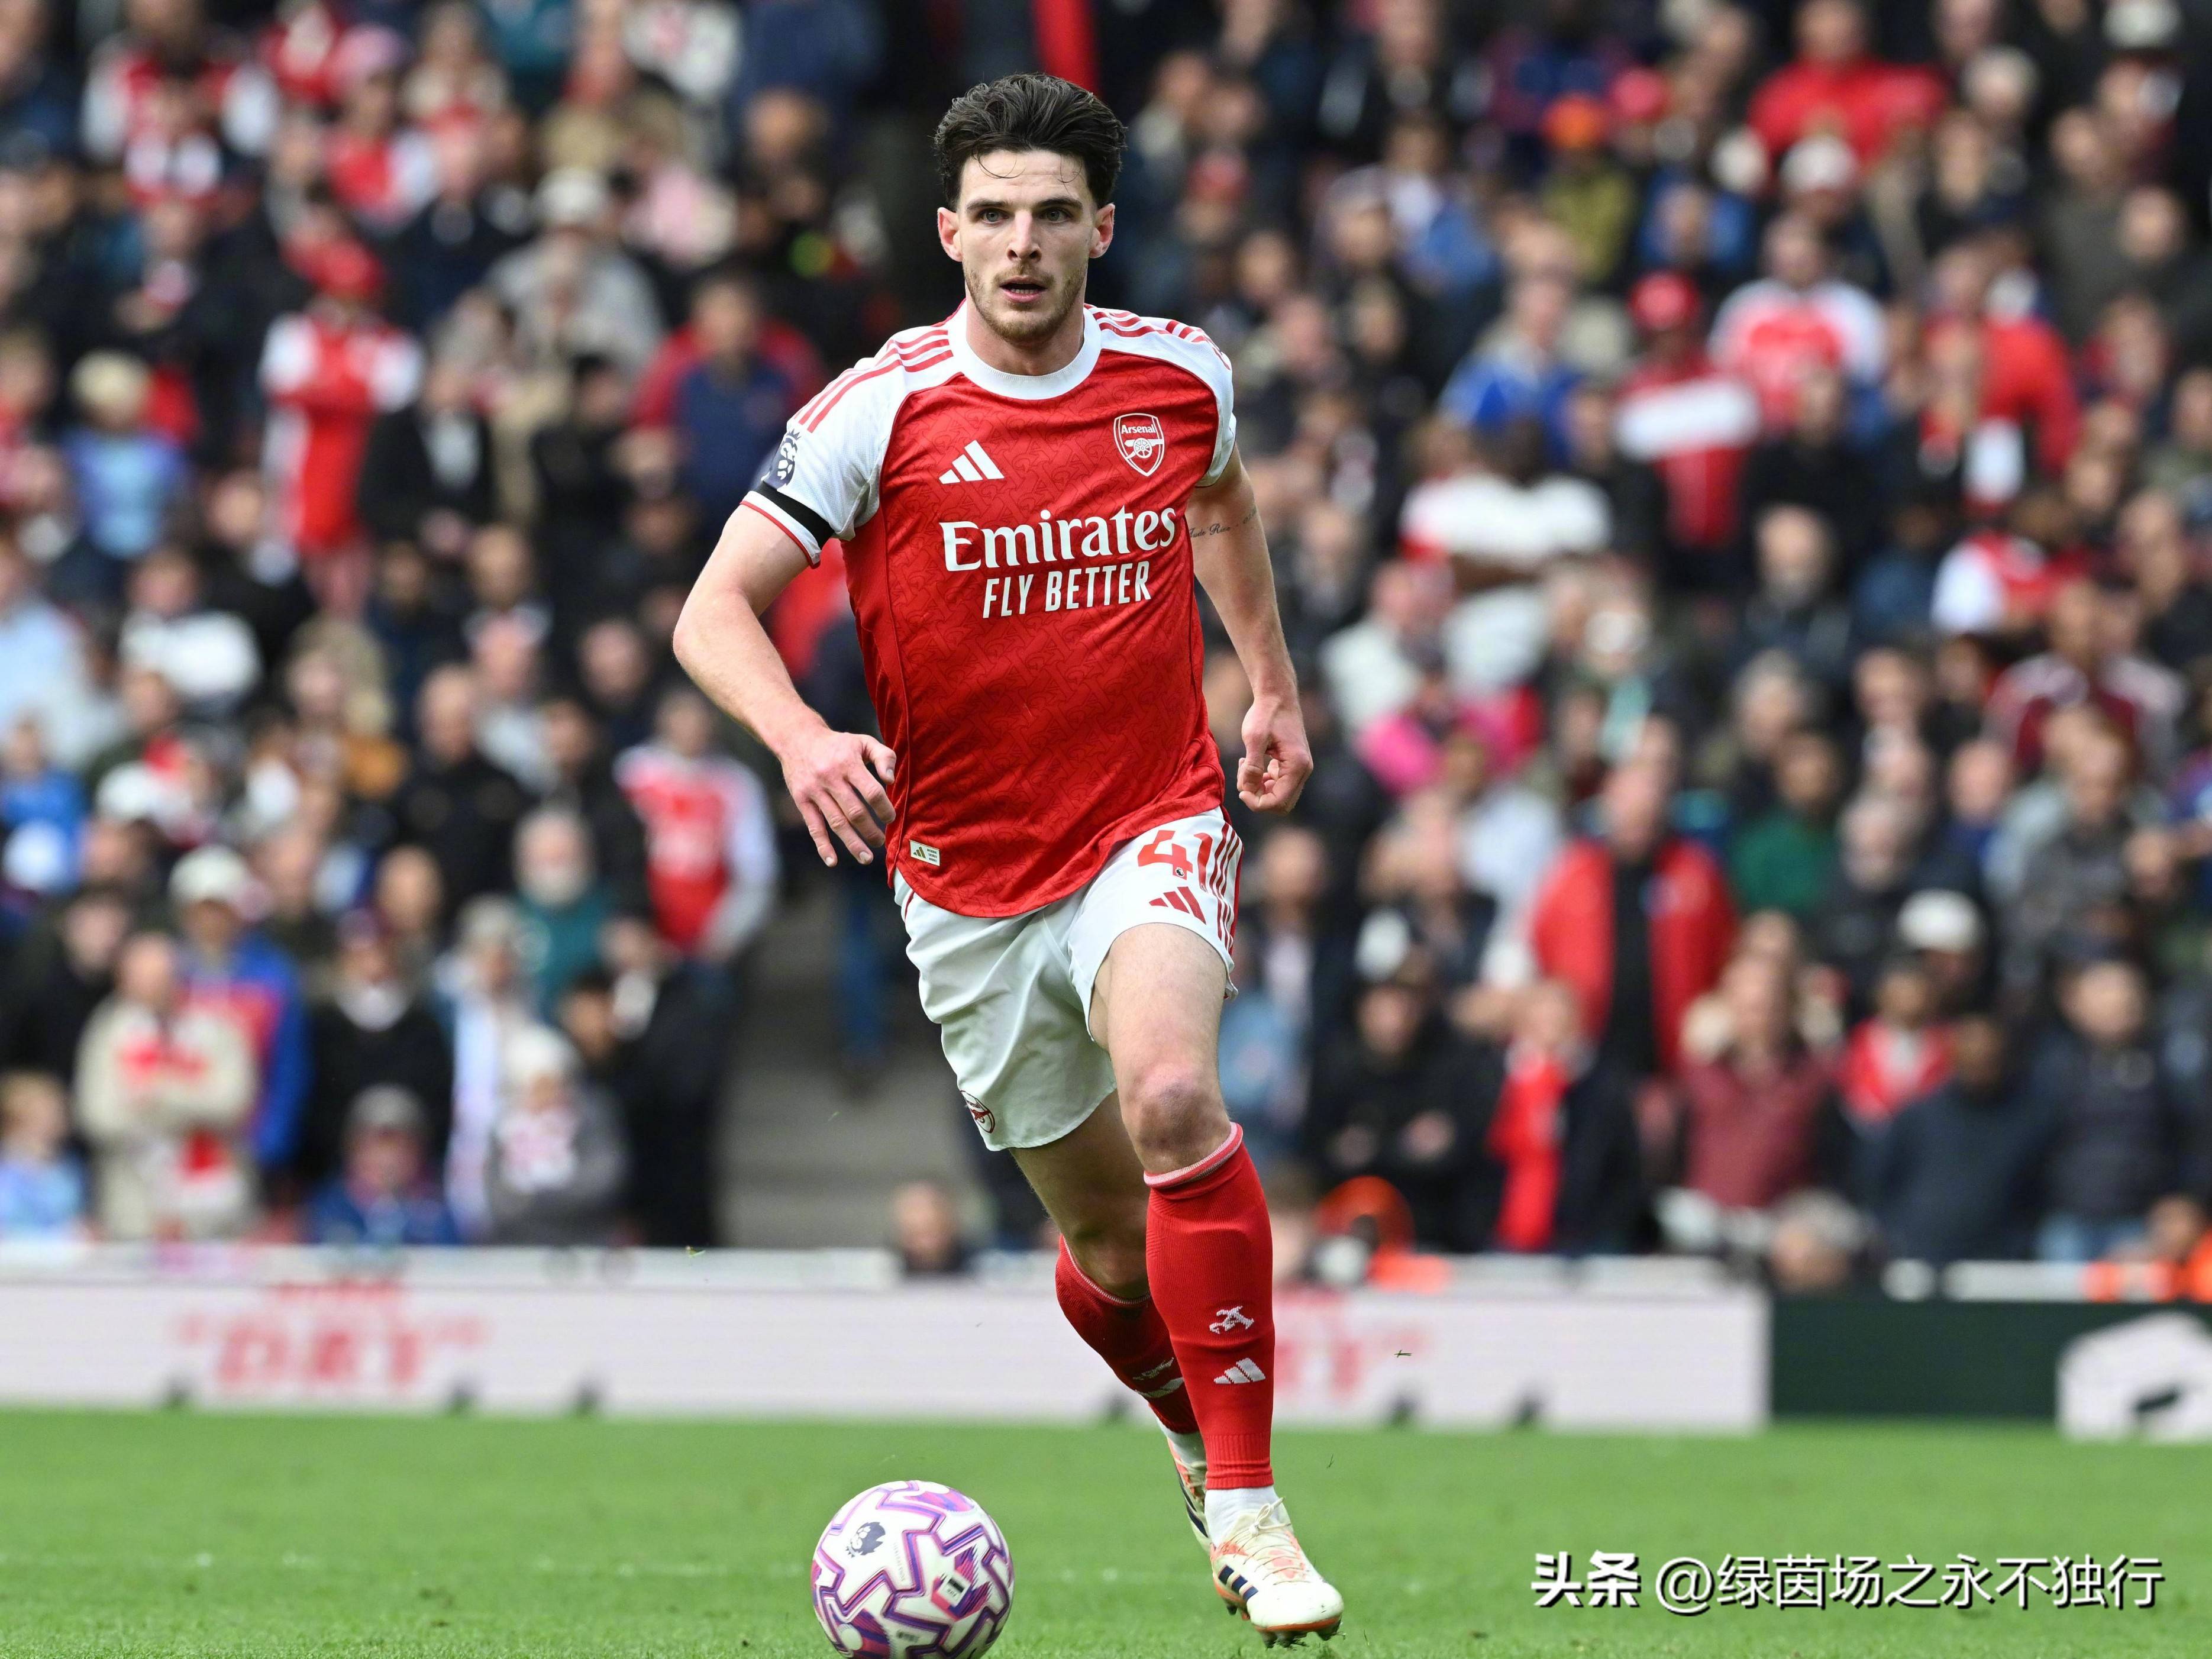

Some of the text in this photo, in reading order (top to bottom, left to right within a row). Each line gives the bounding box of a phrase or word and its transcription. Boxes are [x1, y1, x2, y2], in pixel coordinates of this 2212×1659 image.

[1121, 424, 1157, 434] Arsenal
[939, 505, 1176, 572] Emirates
[983, 561, 1151, 618] FLY BETTER
[1137, 830, 1213, 892] 41
